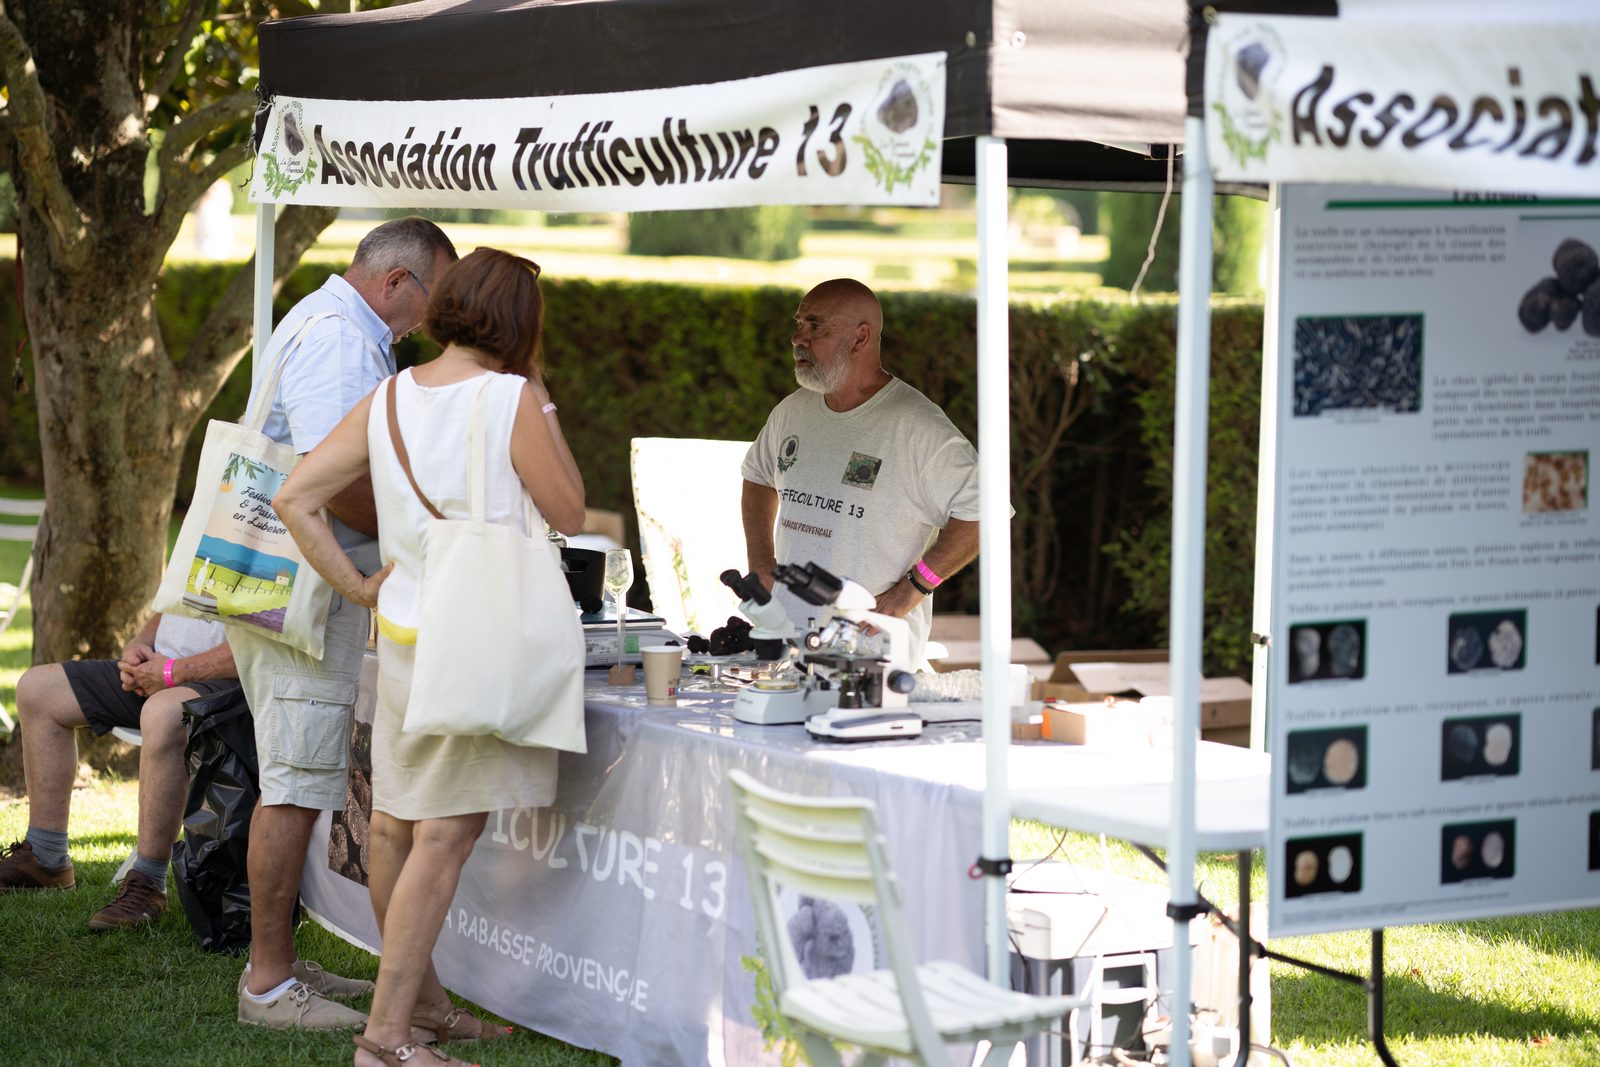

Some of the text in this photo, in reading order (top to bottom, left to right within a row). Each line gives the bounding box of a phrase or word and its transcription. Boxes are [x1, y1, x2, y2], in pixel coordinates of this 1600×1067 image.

[313, 124, 498, 191] Association
[511, 116, 780, 191] Trufficulture
[795, 102, 852, 178] 13
[239, 499, 282, 522] & Passio
[241, 486, 273, 507] Festiva
[778, 488, 865, 519] FFICULTURE 13
[232, 512, 287, 535] en Luberon
[491, 806, 727, 920] ICULTURE 13
[458, 907, 535, 967] RABASSE
